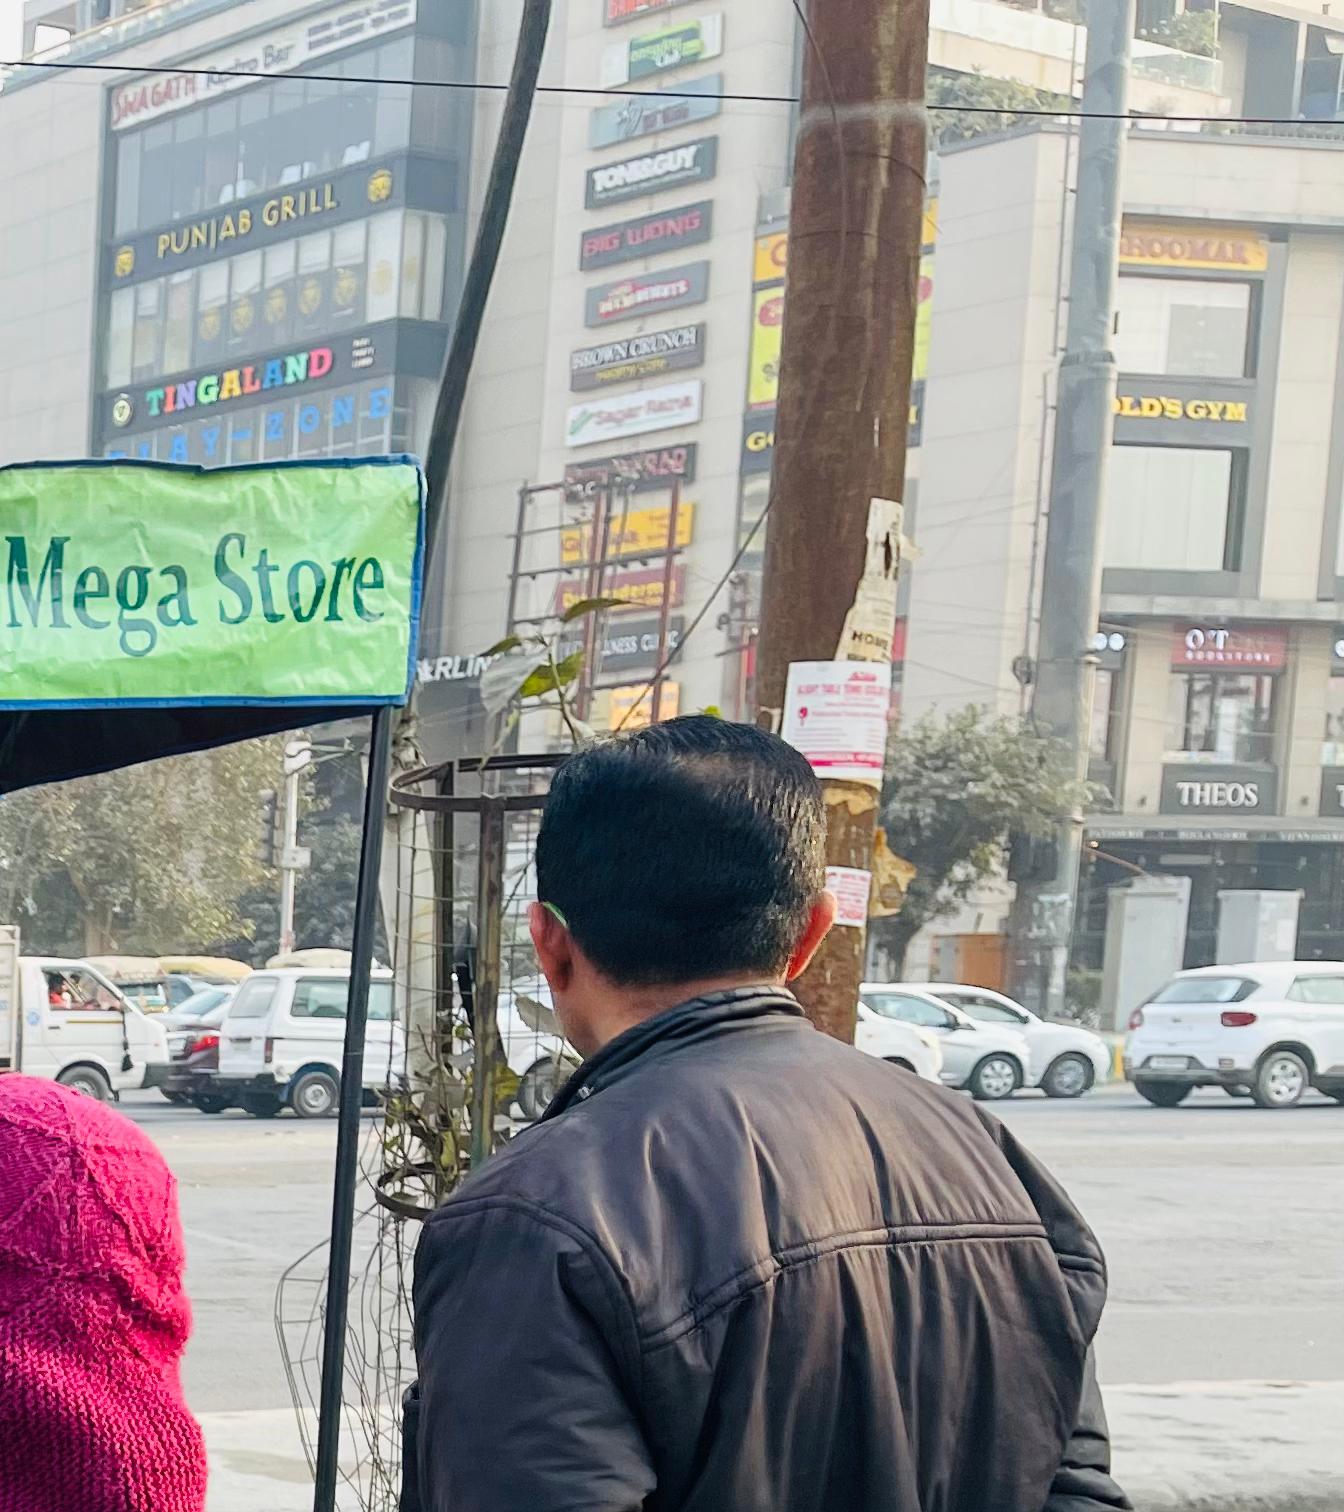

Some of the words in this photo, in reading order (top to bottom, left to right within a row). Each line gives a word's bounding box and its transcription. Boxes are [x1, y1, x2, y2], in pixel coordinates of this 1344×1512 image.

[112, 73, 196, 124] SWAGATH
[157, 210, 251, 259] PUNJAB
[263, 183, 338, 229] GRILL
[583, 231, 621, 258] BIG
[145, 347, 333, 416] TINGALAND
[1185, 400, 1247, 422] GYM
[5, 535, 199, 658] Mega
[213, 532, 385, 625] Store
[1176, 782, 1260, 808] THEOS
